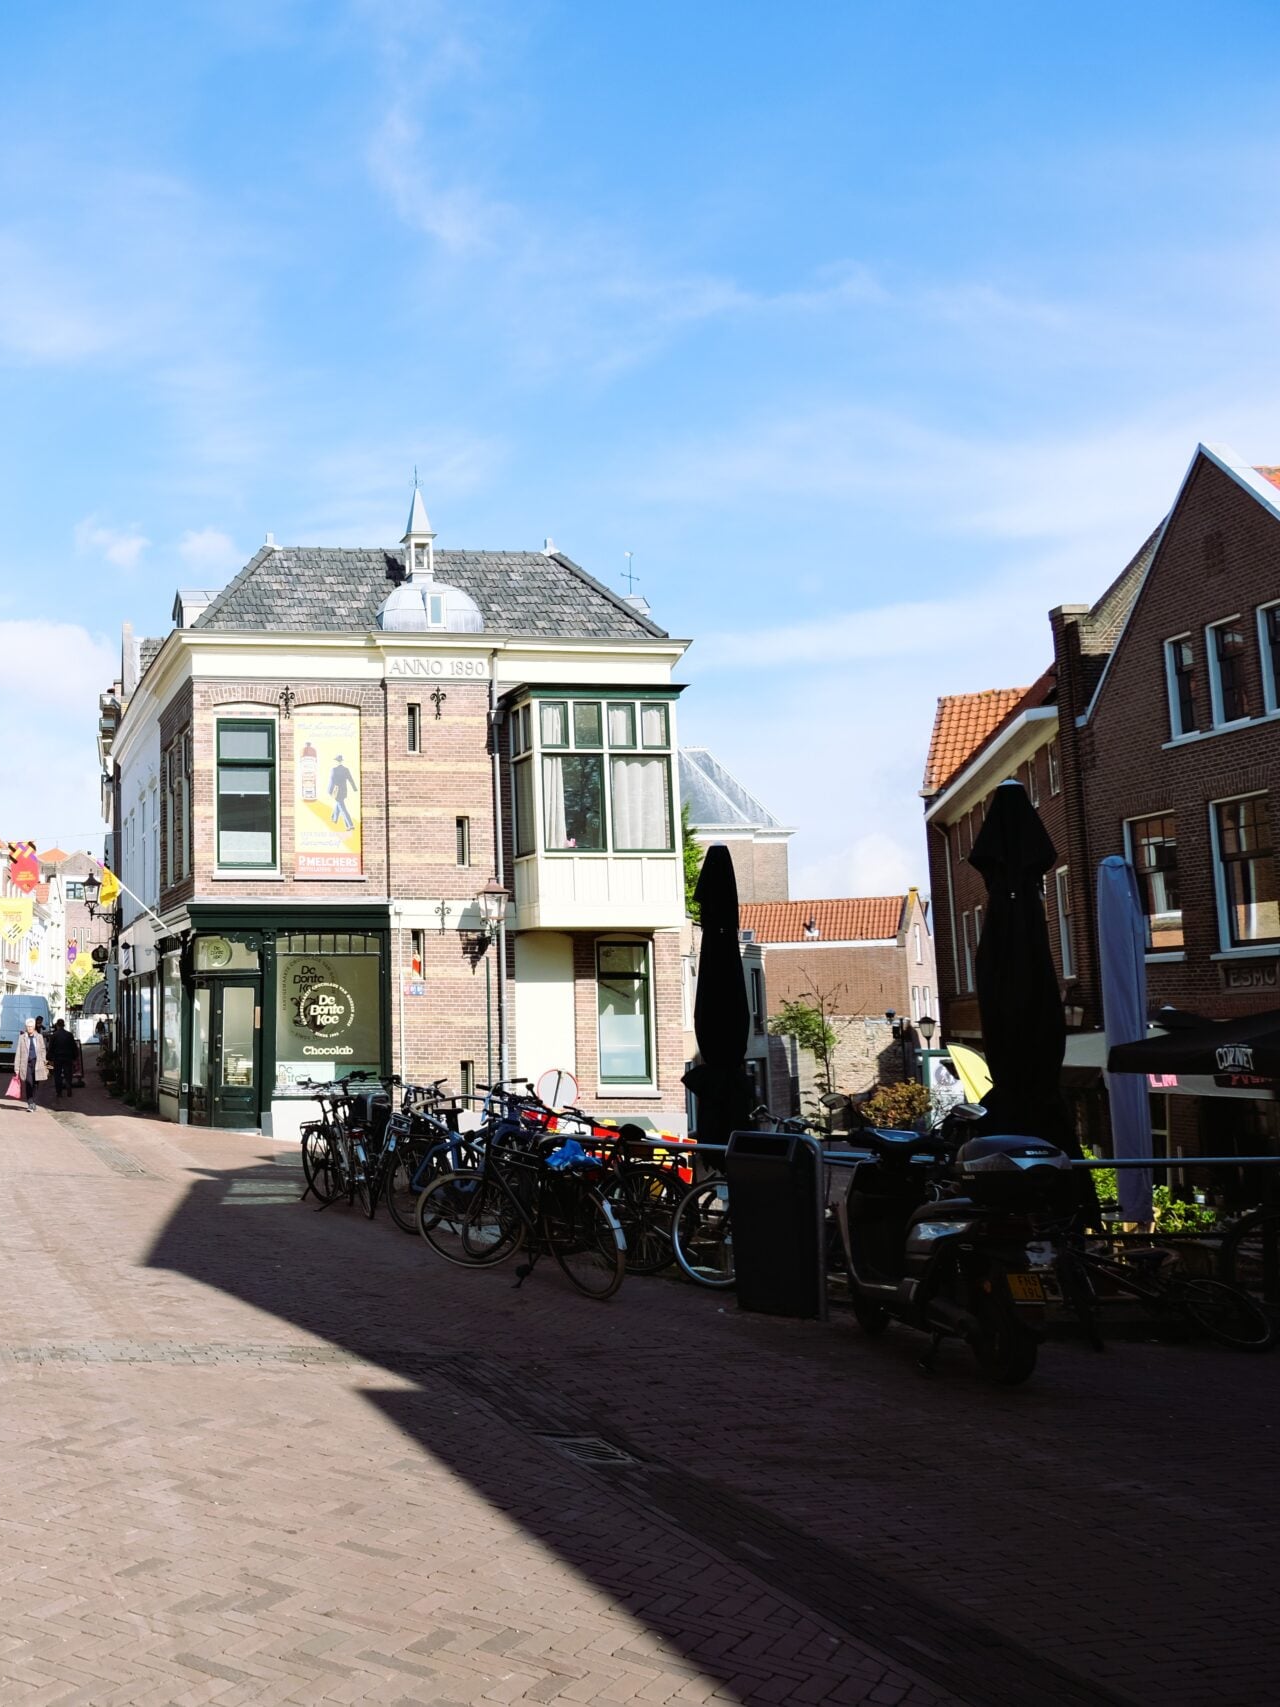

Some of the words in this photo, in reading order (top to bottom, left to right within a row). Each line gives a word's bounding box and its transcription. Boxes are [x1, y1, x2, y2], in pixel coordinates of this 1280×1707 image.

[389, 658, 442, 675] ANNO
[319, 994, 335, 1005] De
[310, 1003, 345, 1015] Bonte
[317, 1014, 339, 1026] Koe
[302, 1045, 354, 1055] Chocolab
[1215, 1047, 1255, 1071] CORNET
